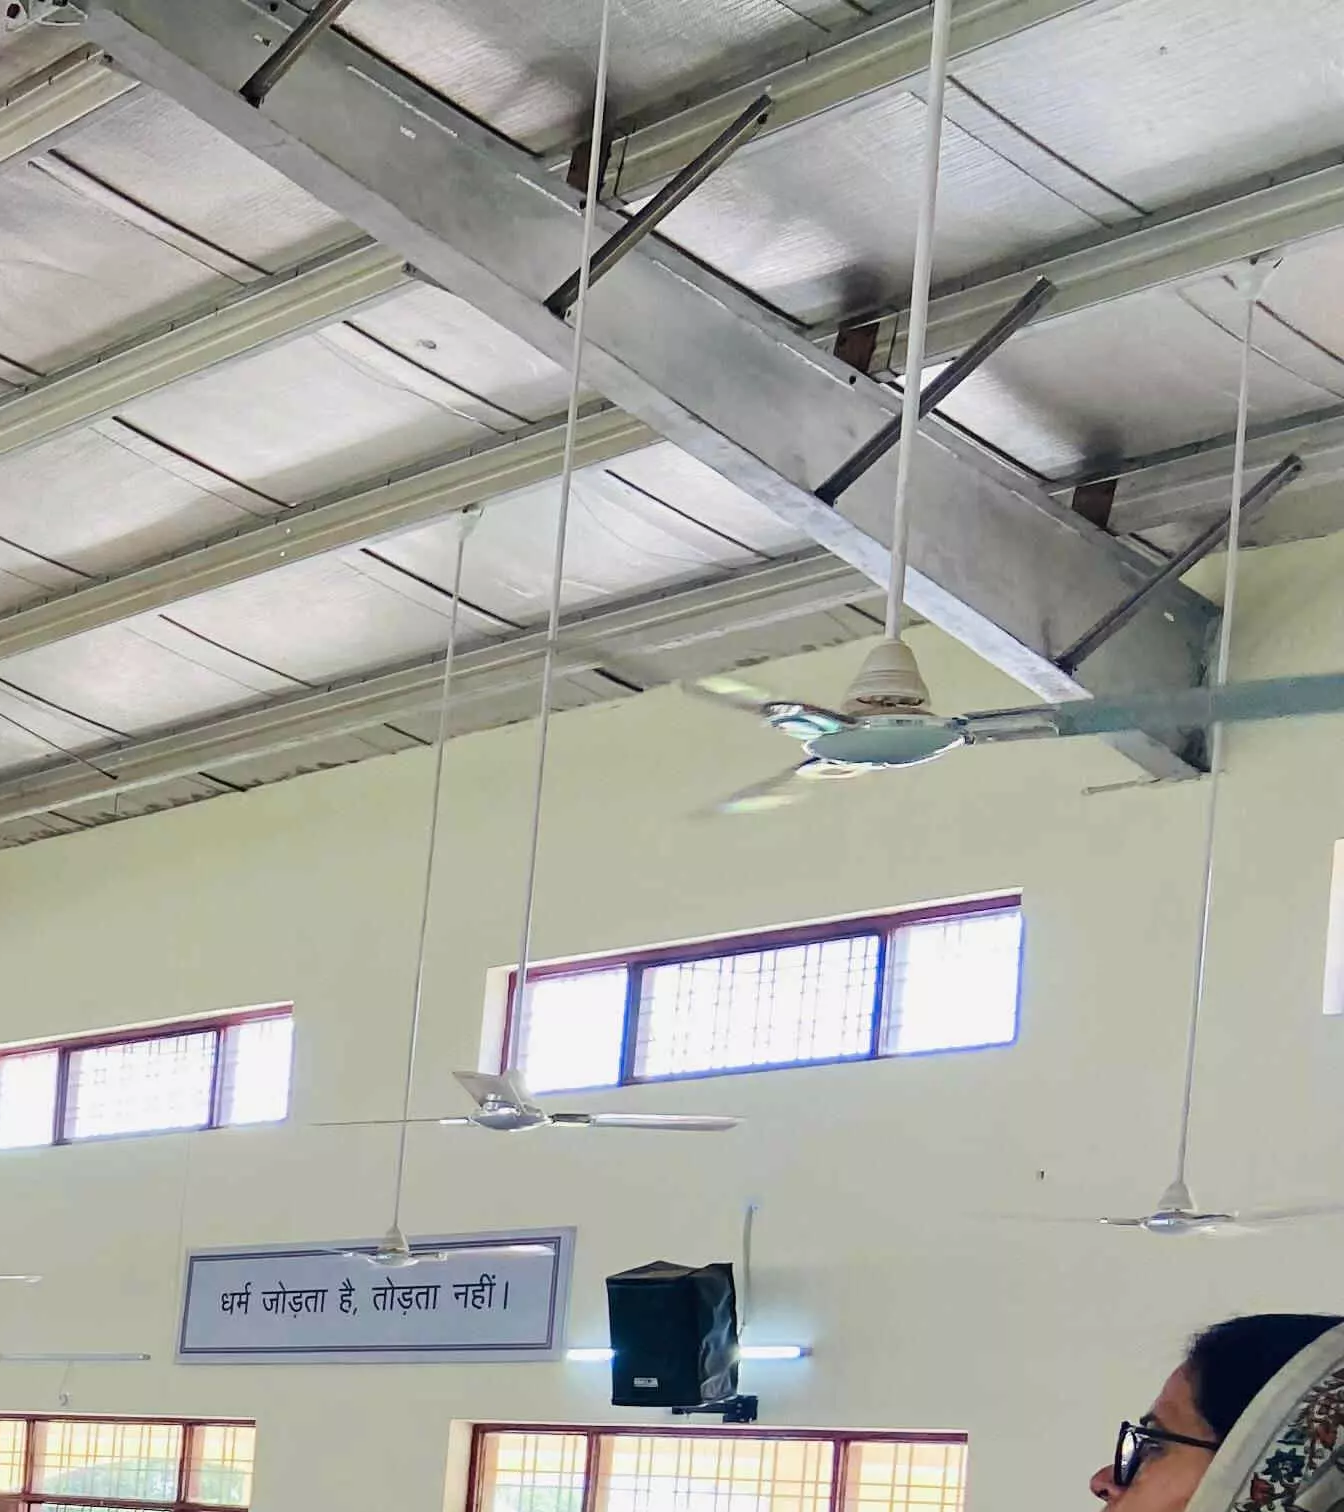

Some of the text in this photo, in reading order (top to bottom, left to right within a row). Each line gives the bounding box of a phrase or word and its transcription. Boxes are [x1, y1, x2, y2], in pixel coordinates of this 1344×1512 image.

[221, 1282, 251, 1315] धर्म
[261, 1280, 328, 1318] जोड़ता
[338, 1277, 358, 1316] है,
[372, 1276, 441, 1316] तोड़ता
